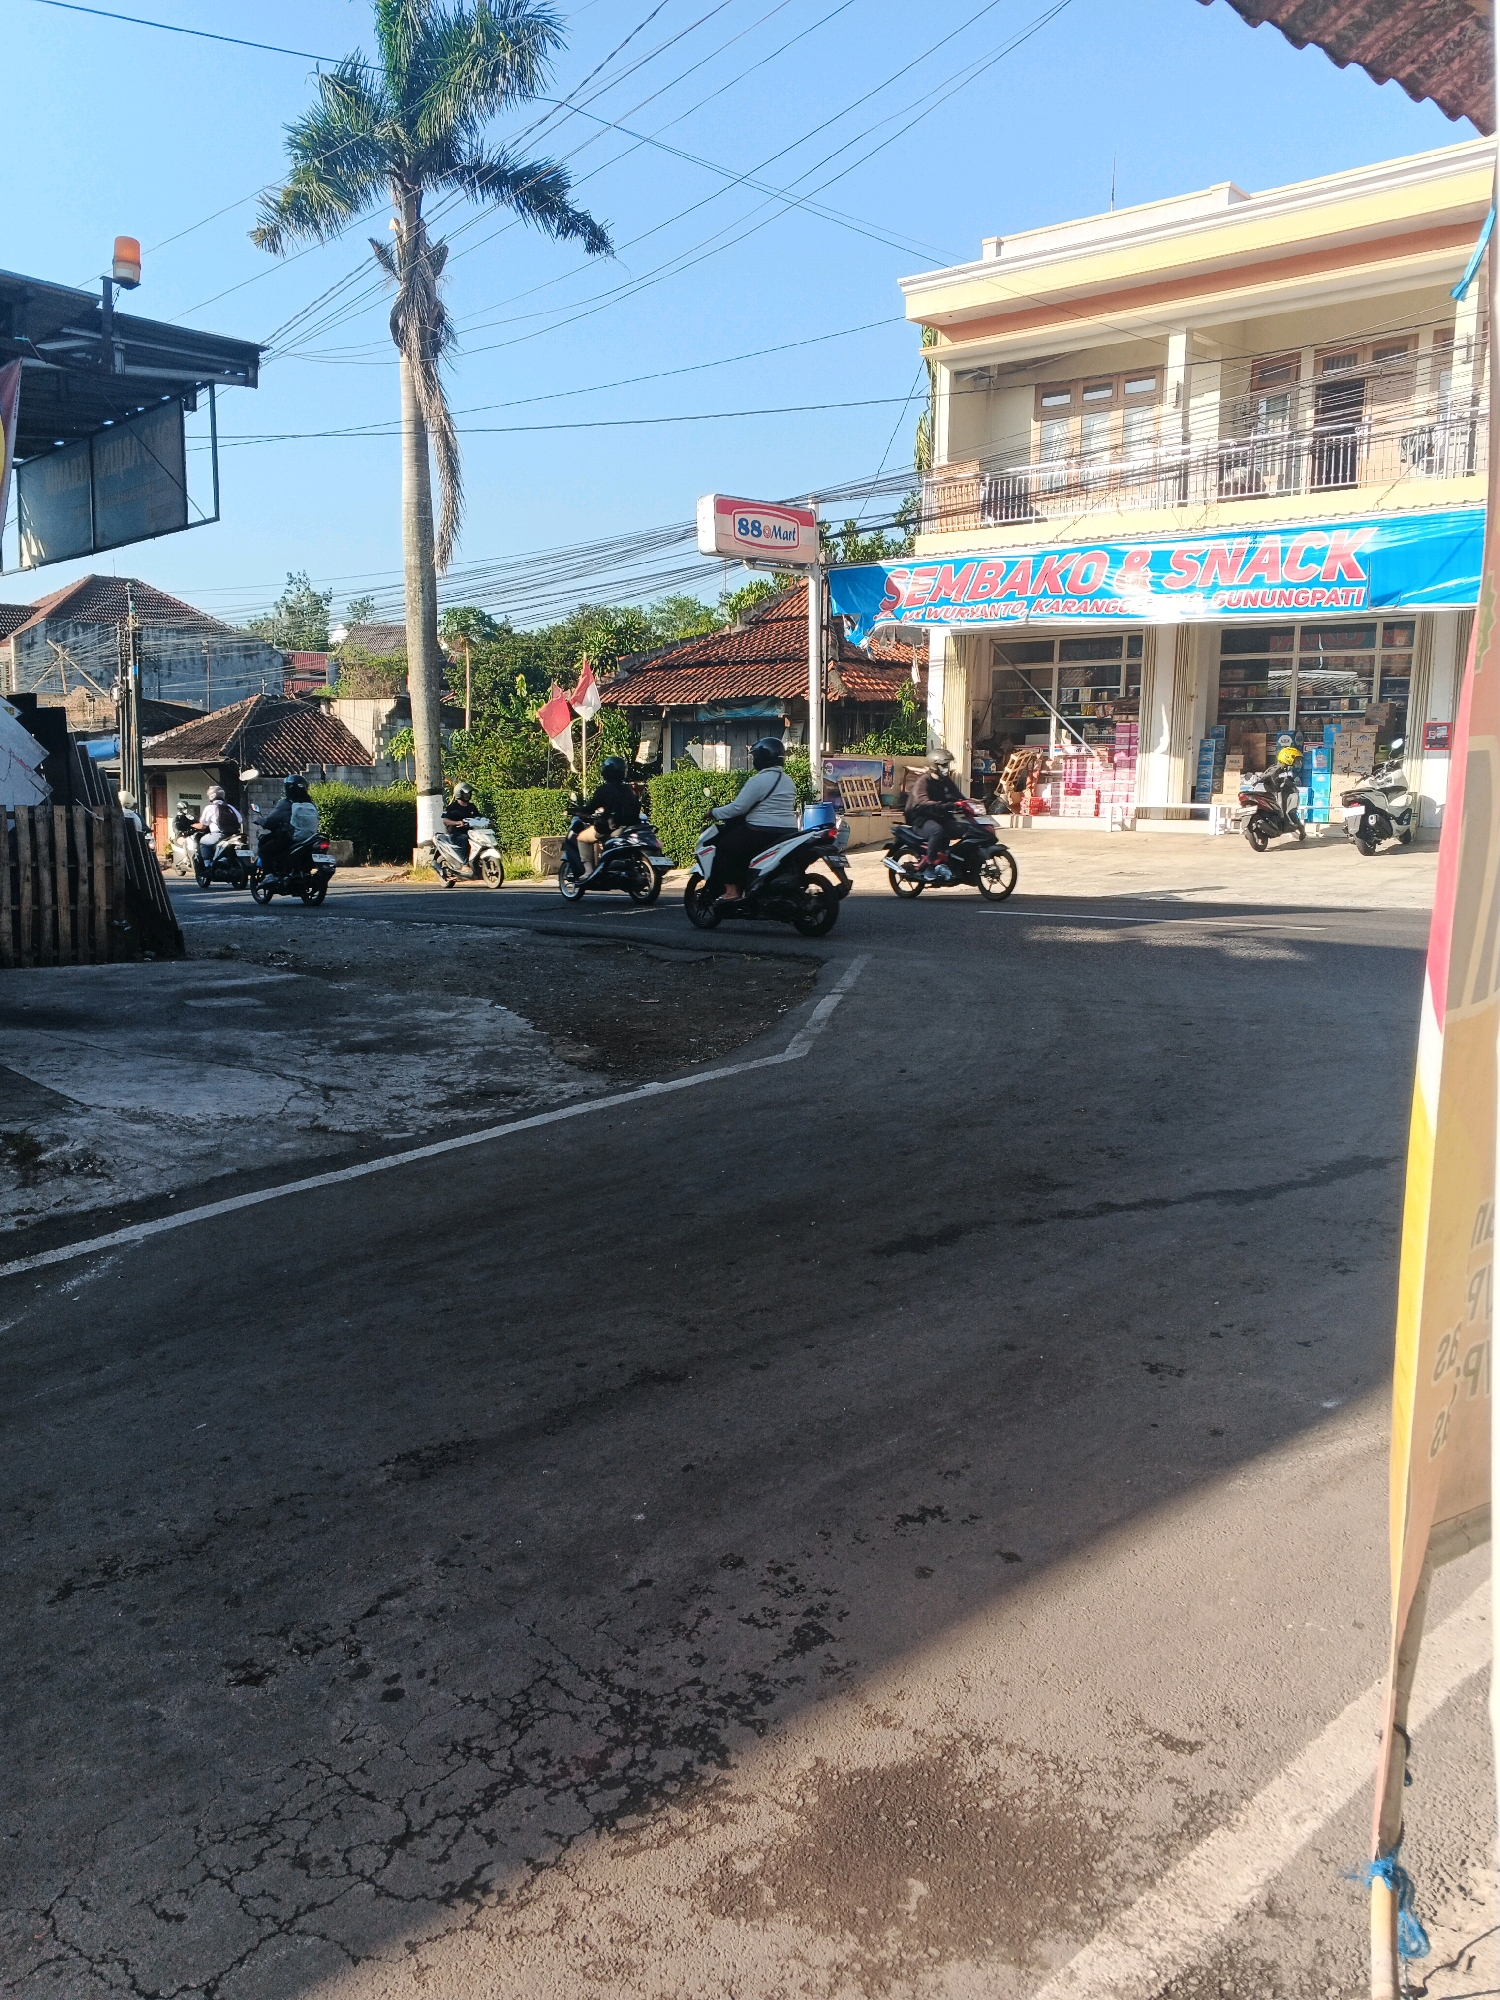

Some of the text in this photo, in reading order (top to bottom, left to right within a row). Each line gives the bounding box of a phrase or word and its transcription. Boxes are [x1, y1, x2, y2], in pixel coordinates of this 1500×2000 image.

[737, 517, 797, 542] 88 Mart
[880, 527, 1378, 611] SEMBAKO & SNACK
[926, 601, 1028, 621] WURYANTO,
[1212, 588, 1365, 608] GUNUNGPATI
